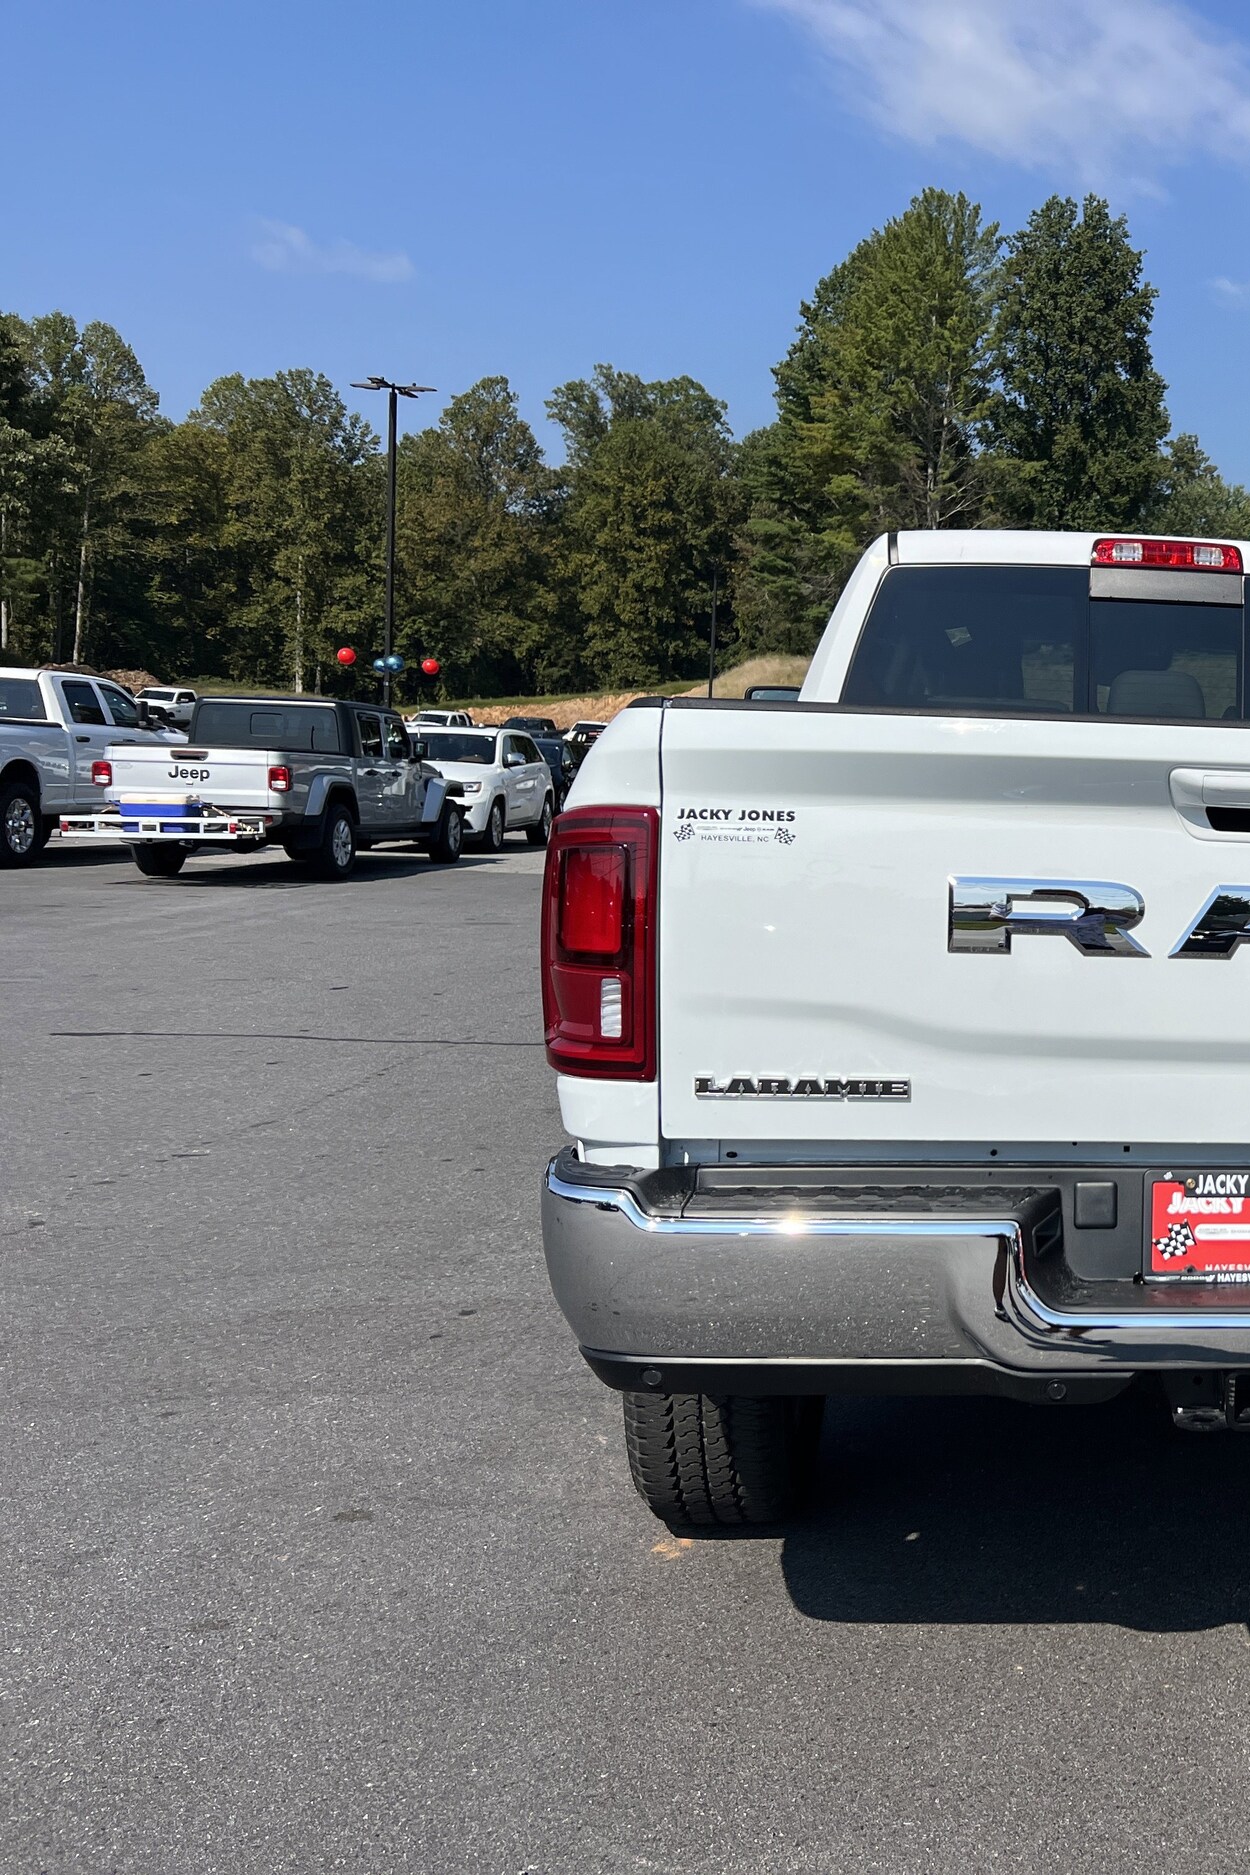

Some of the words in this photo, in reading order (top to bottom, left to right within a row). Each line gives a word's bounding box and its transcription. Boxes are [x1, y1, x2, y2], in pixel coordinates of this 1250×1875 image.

[168, 765, 210, 781] Jeep
[677, 808, 733, 821] JACKY
[738, 809, 796, 822] JONES
[700, 834, 756, 843] HAYESVILLE,
[695, 1074, 911, 1103] LARAMIE
[1195, 1174, 1249, 1195] JACKY
[1167, 1192, 1245, 1215] JACKY
